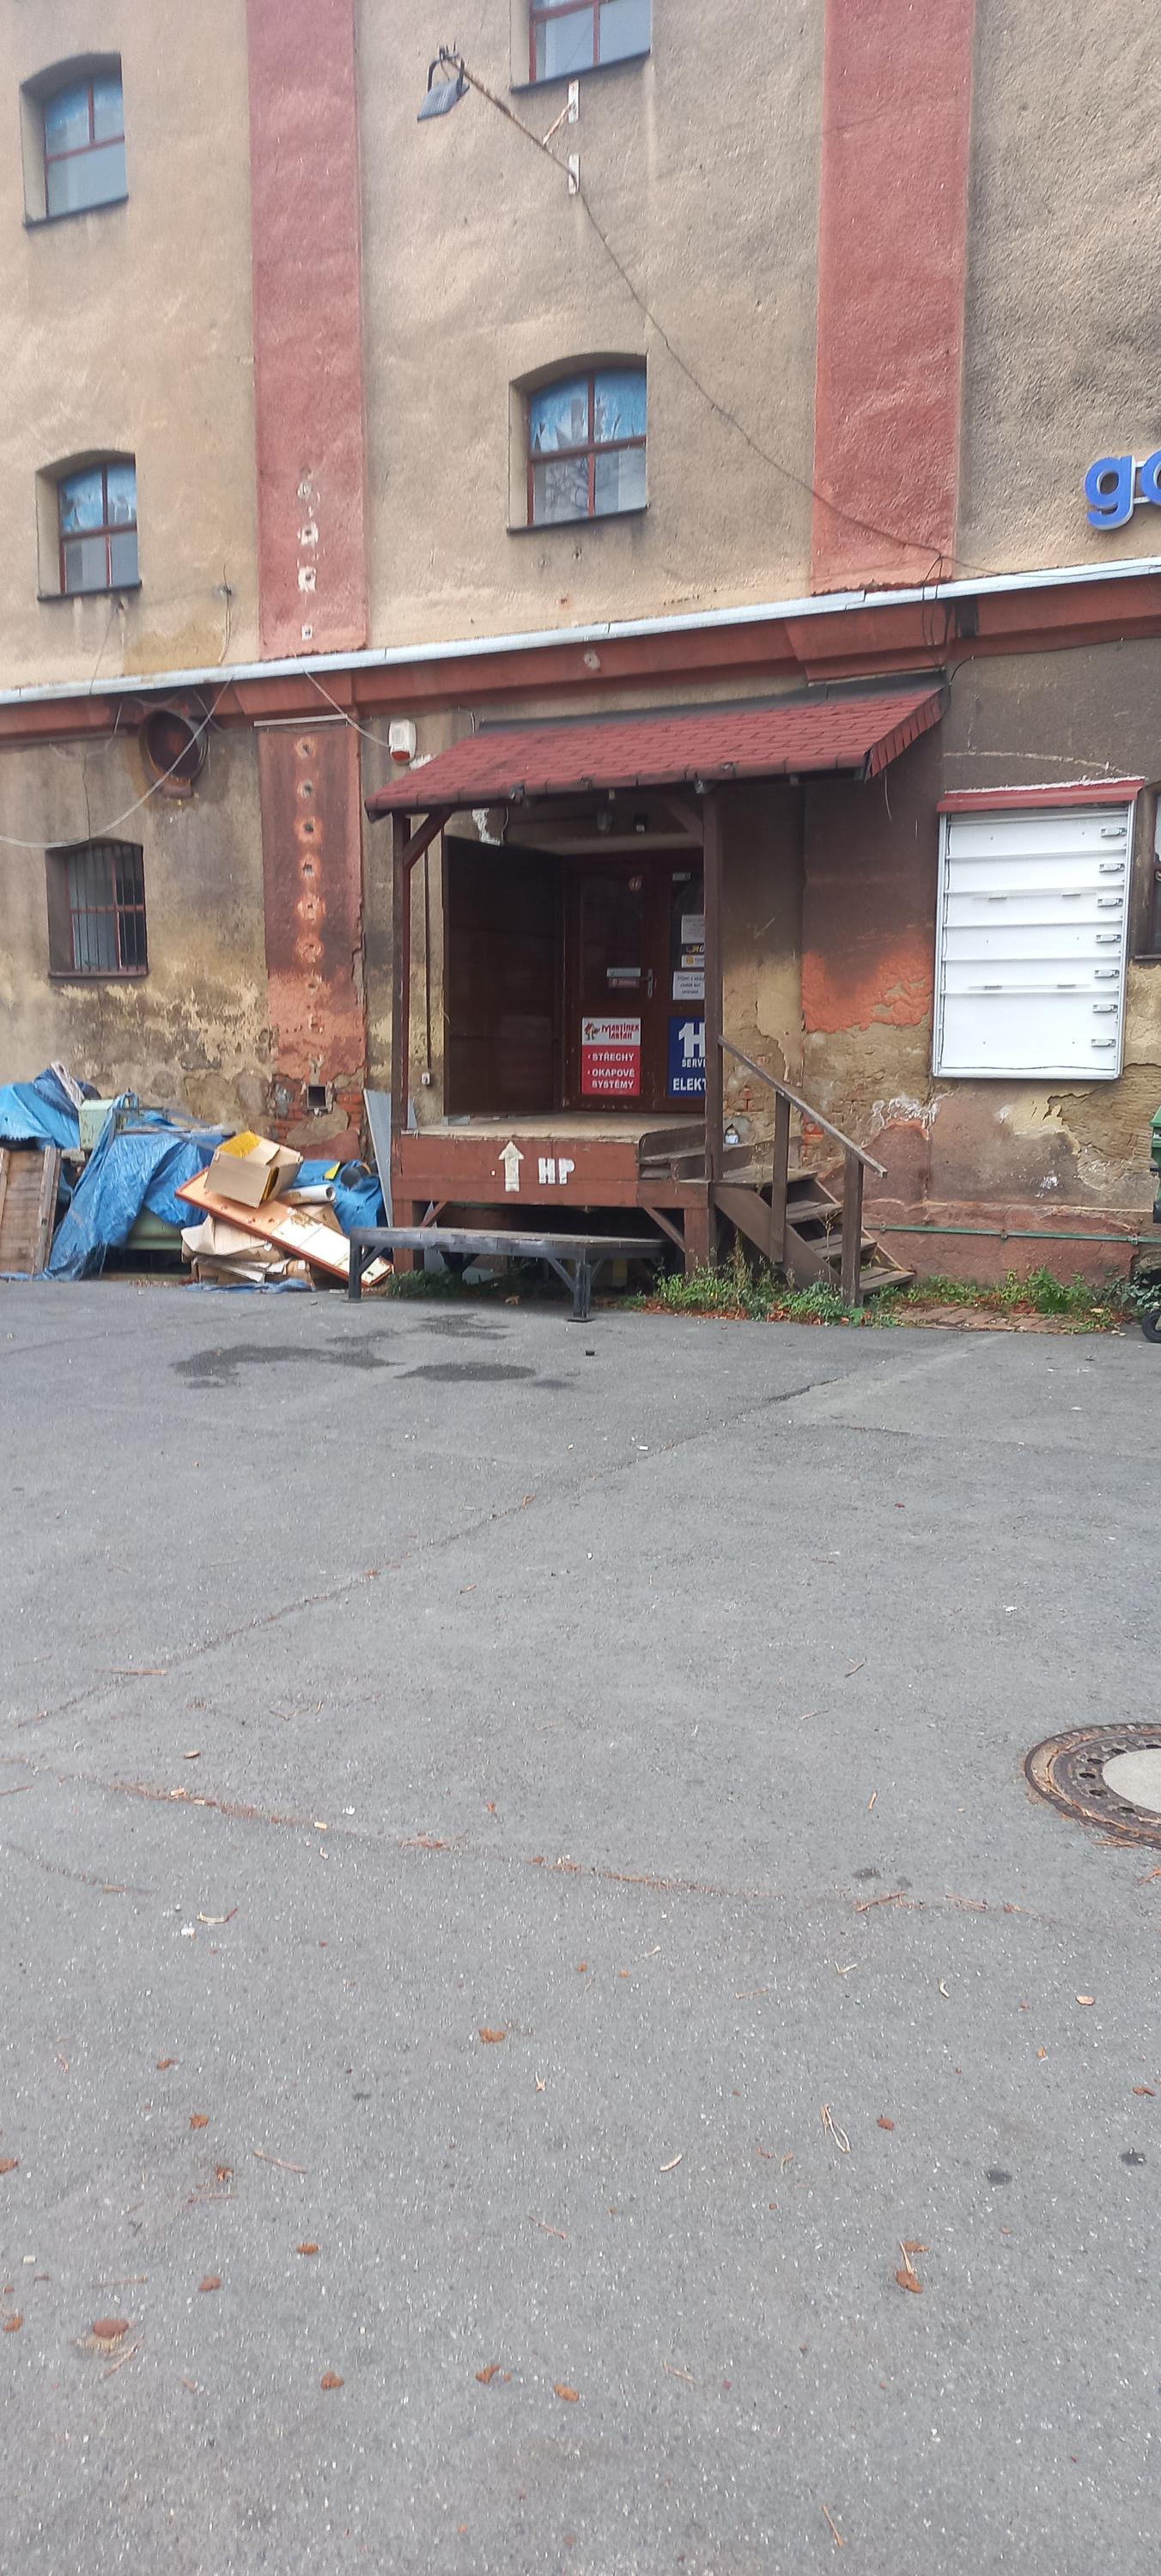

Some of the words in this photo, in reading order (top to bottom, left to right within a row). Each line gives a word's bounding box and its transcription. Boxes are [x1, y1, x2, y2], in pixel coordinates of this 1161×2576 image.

[592, 1051, 635, 1061] STŘECHY
[592, 1067, 635, 1078] OKAPOVÉ
[592, 1079, 634, 1090] SYSTÉMY
[538, 1157, 575, 1184] HP
